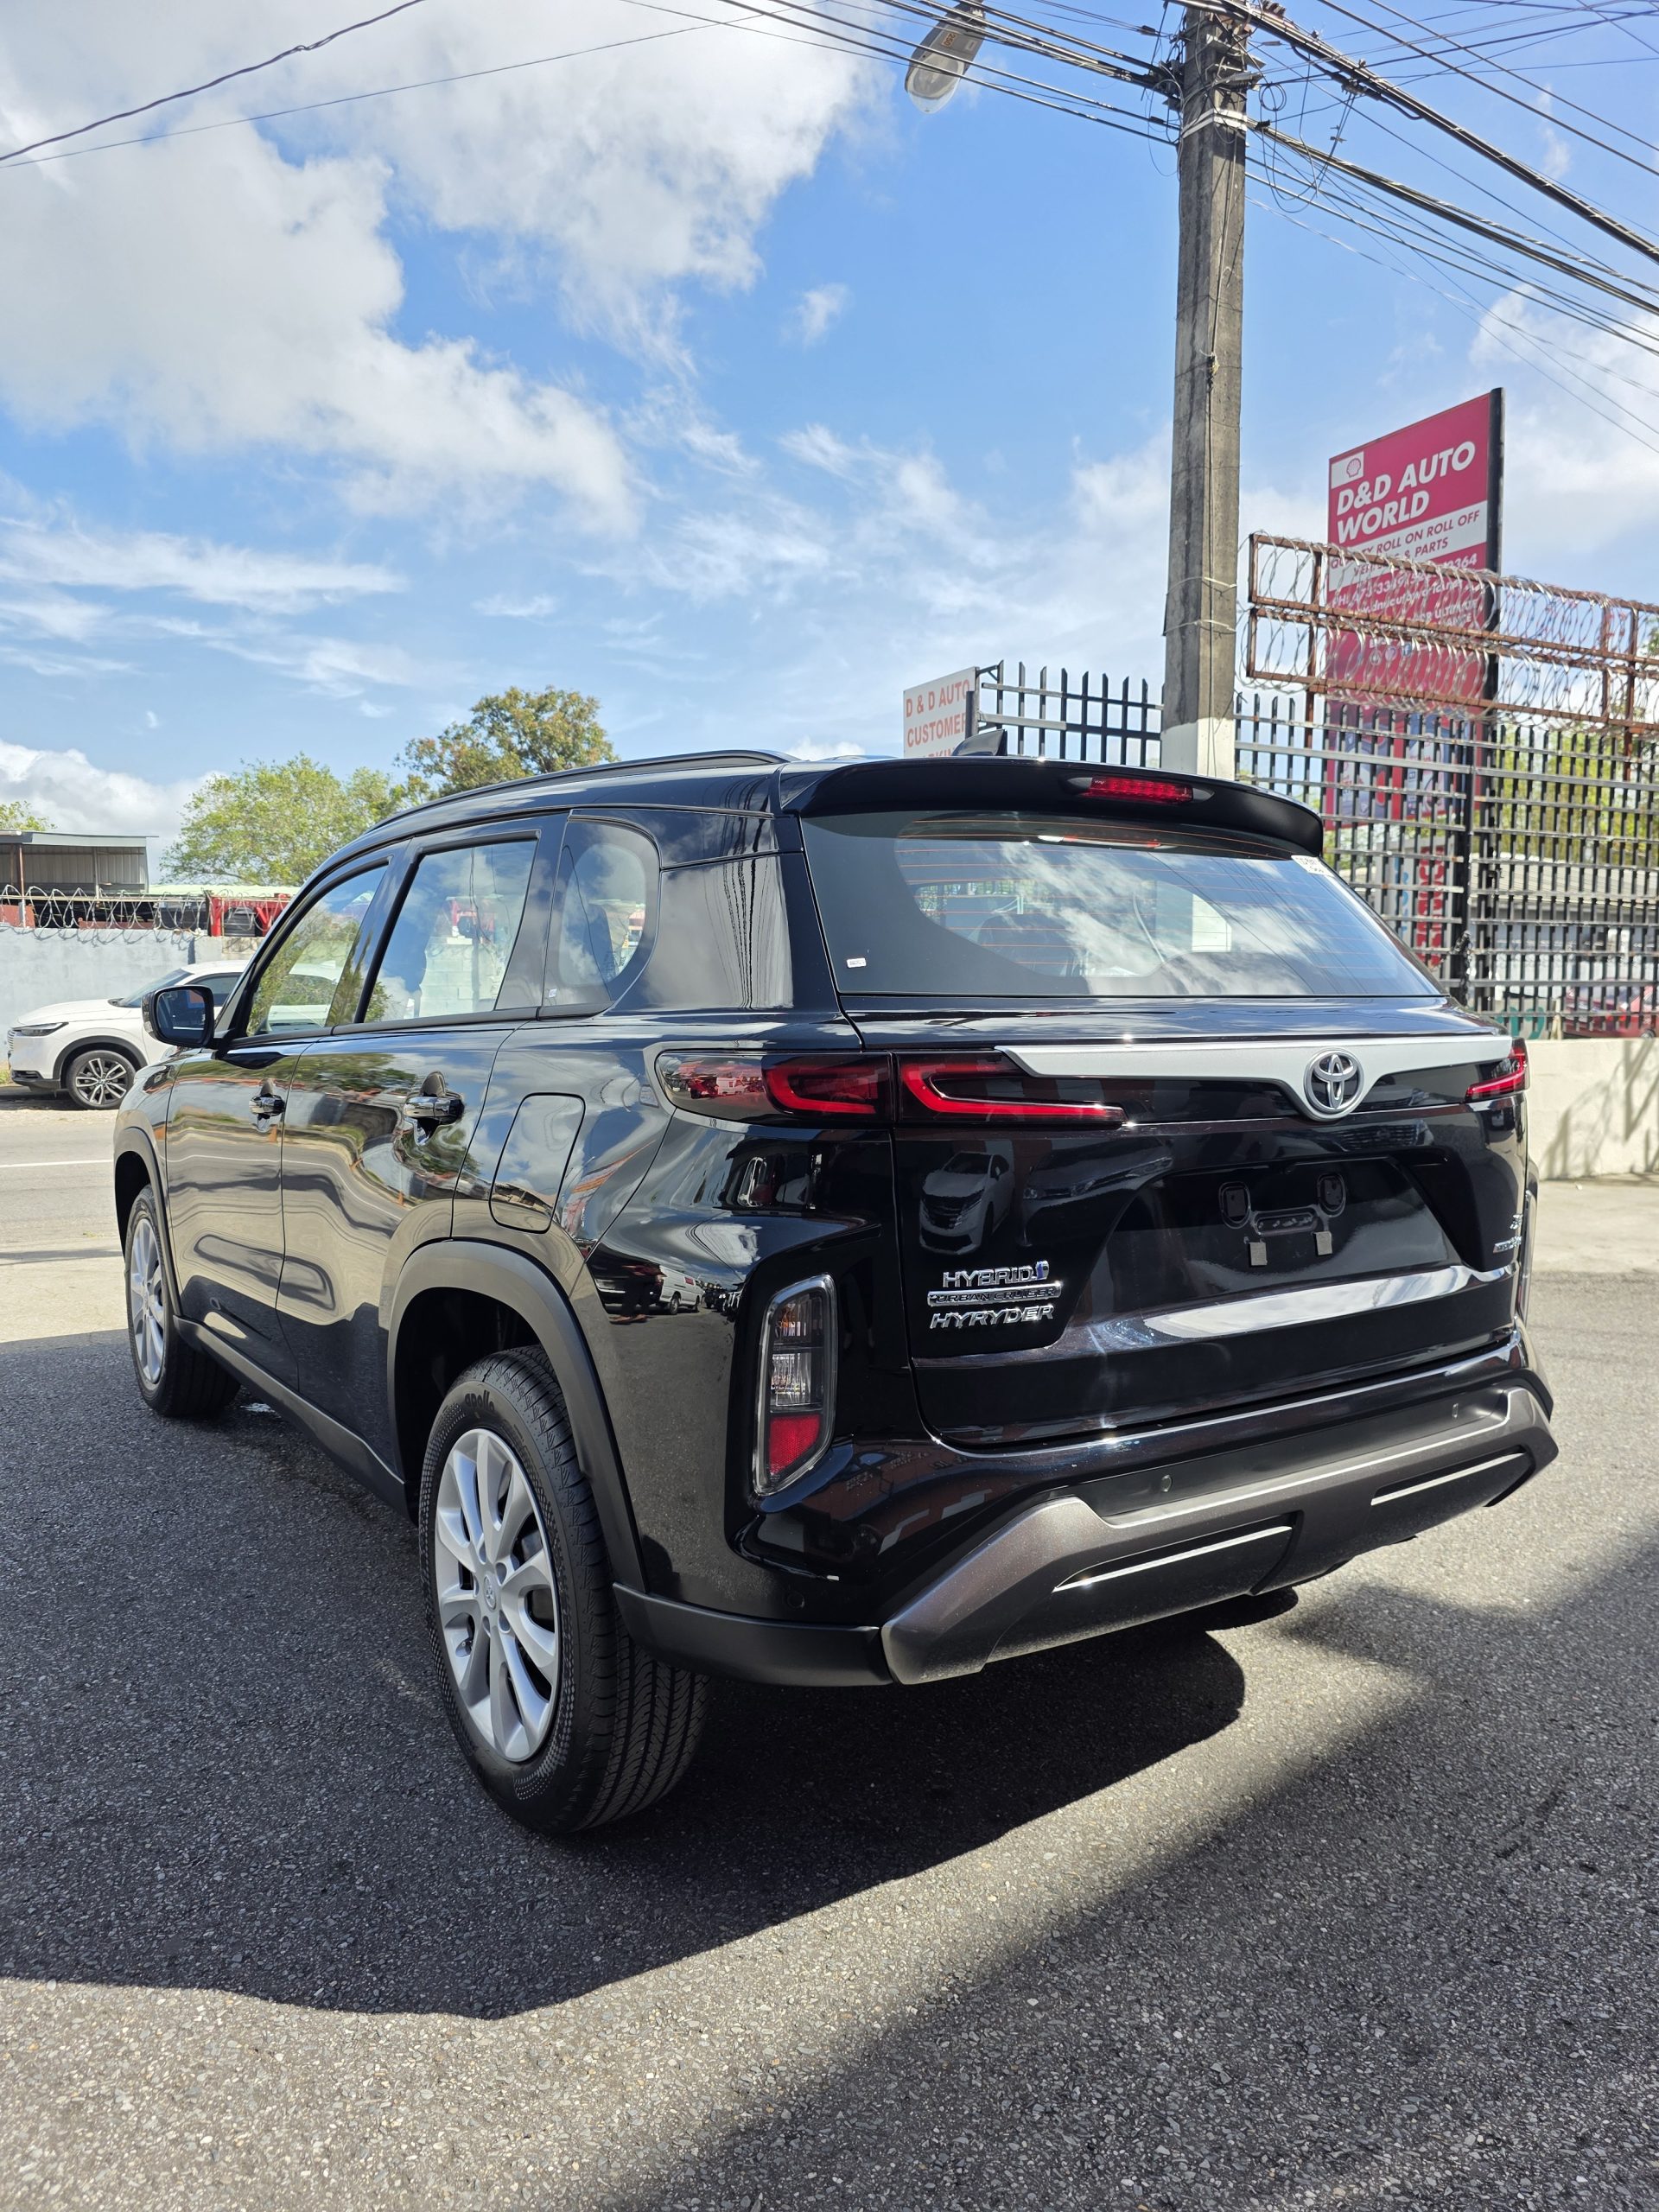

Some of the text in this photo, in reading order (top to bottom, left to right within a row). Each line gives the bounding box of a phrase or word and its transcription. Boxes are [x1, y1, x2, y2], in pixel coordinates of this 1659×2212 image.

[944, 33, 956, 46] 250
[1337, 441, 1476, 515] D&D AUTO
[1338, 490, 1429, 544] WORLD
[1376, 535, 1402, 555] ROLL
[1405, 530, 1423, 543] ON
[1427, 520, 1453, 538] ROLL
[1458, 511, 1480, 526] OFF
[1414, 537, 1448, 558] PARTS
[906, 679, 969, 718] D & D AUTO
[943, 1265, 1034, 1288] HYBRID
[937, 1286, 1055, 1303] URBAN CRUISER
[930, 1304, 1055, 1329] HYRYDER
[465, 1389, 495, 1412] apollo
